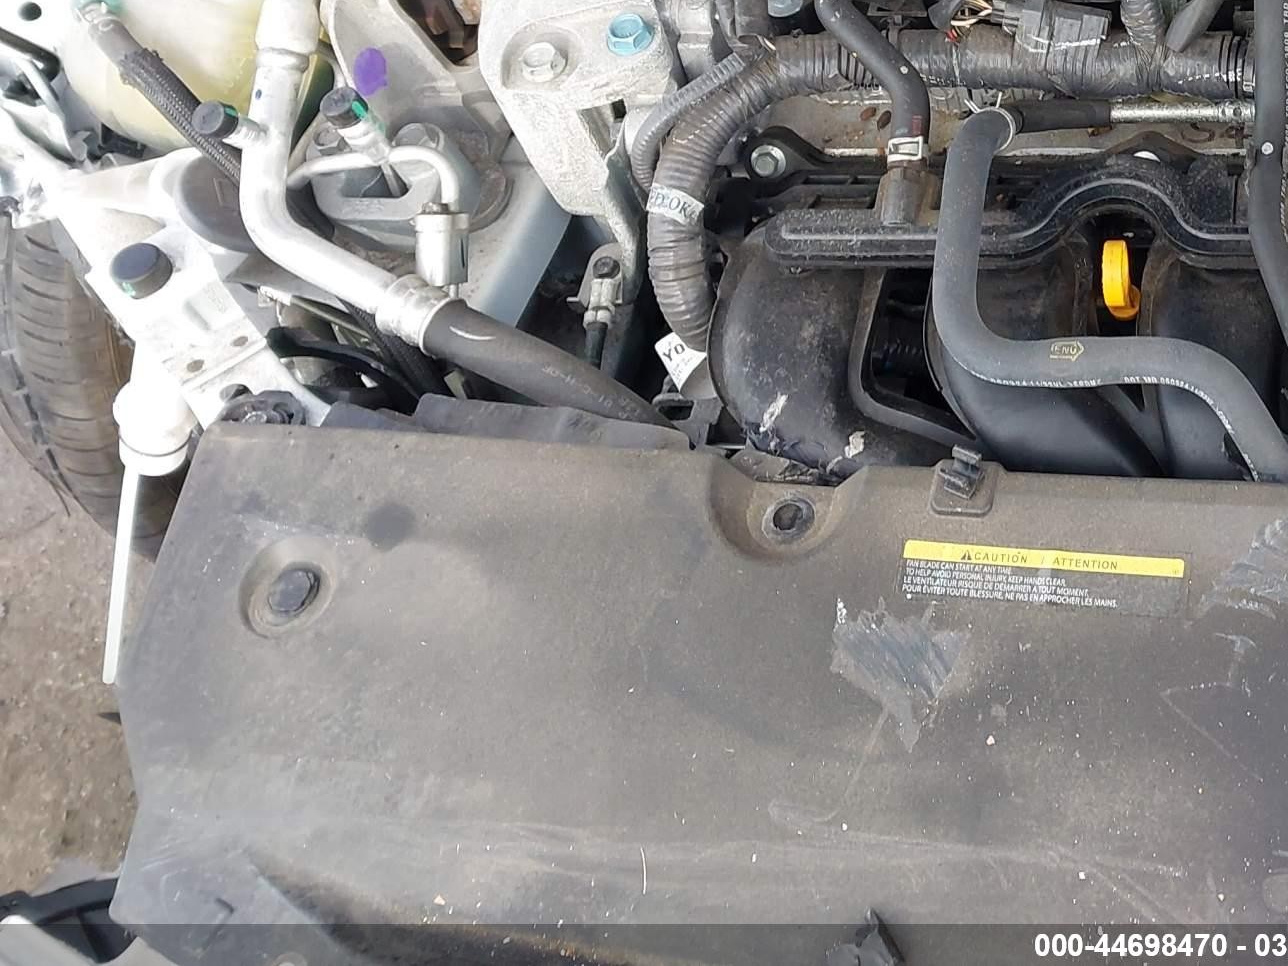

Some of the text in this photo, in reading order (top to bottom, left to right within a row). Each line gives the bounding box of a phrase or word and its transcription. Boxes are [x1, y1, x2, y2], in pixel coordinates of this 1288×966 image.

[919, 561, 940, 569] BLADE
[941, 562, 954, 570] CAN
[955, 564, 974, 572] START
[983, 565, 996, 573] ANY
[974, 552, 1028, 564] CAUTION
[1053, 557, 1118, 571] ATTENTION
[915, 569, 931, 577] HELP
[932, 570, 951, 578] AVOID
[952, 571, 983, 581] PERSONAL
[1008, 575, 1023, 583] KEEP
[913, 577, 957, 588] VENTILATEUR
[958, 581, 982, 589] RISQUE
[983, 582, 993, 590] DE
[1038, 585, 1055, 594] TOUT
[902, 584, 921, 592] POUR
[946, 587, 968, 597] TOUTE
[1004, 592, 1014, 600] NE
[1016, 593, 1028, 601] PAS
[1030, 594, 1038, 602] EN
[1039, 594, 1080, 605] APPROCHER
[1081, 597, 1092, 606] LES
